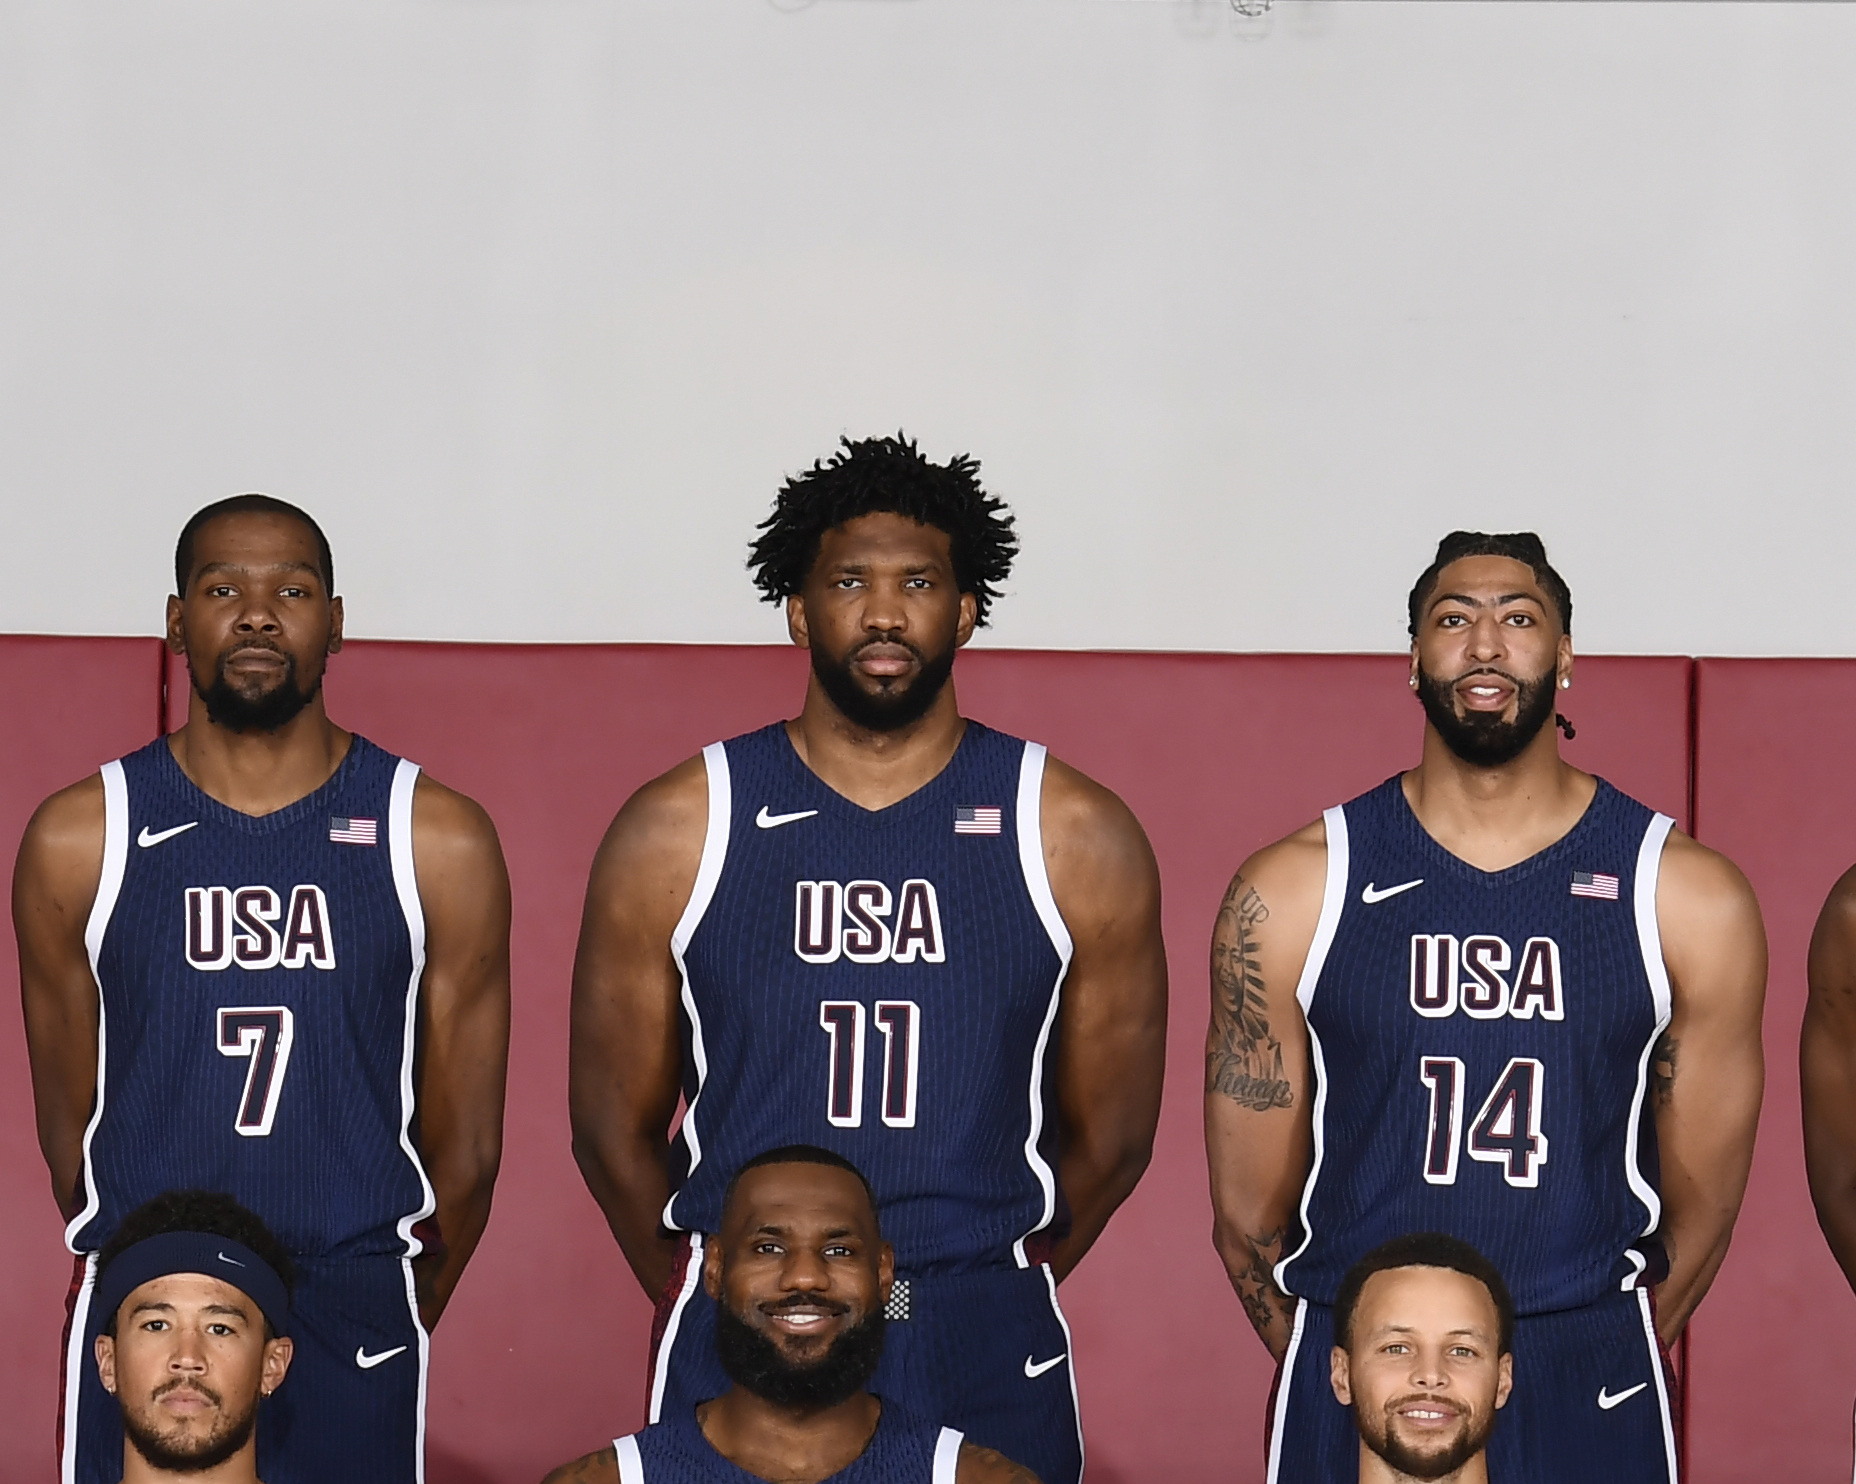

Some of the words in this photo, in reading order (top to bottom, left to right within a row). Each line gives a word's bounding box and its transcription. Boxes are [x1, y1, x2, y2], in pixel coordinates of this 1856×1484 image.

[184, 884, 336, 971] USA
[794, 878, 946, 964] USA
[1409, 934, 1565, 1021] USA
[216, 1005, 294, 1137] 7
[819, 1000, 921, 1128] 11
[1420, 1055, 1549, 1188] 14
